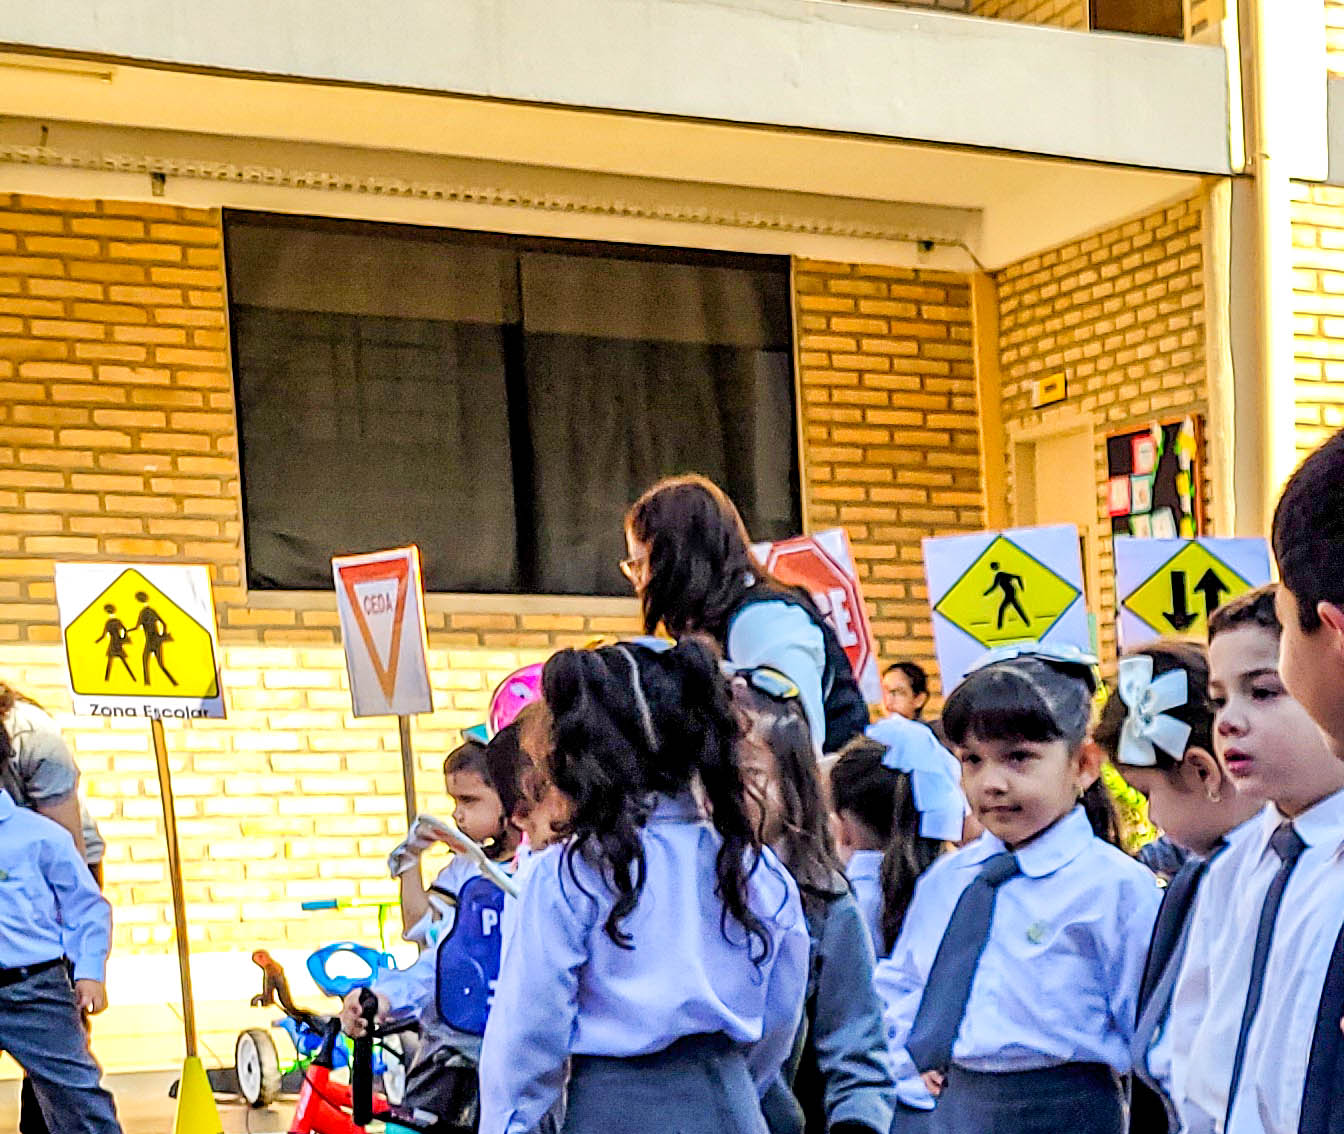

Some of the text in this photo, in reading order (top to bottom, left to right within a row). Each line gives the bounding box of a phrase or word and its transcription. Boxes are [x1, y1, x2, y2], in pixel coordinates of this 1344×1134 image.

[362, 591, 393, 616] CEDA
[89, 703, 209, 719] Zona Escolar
